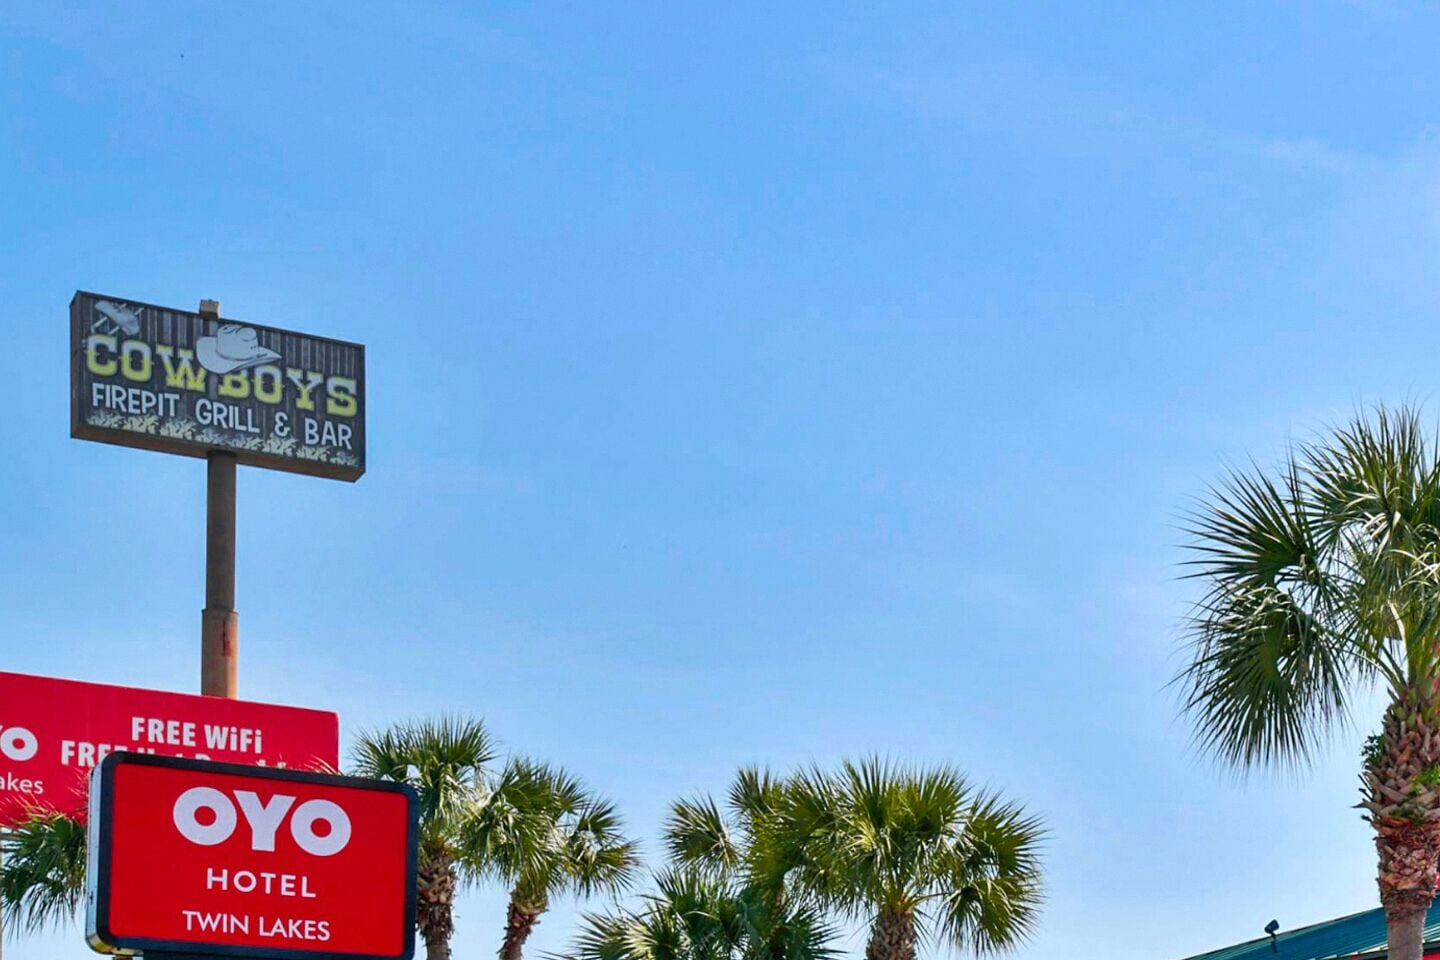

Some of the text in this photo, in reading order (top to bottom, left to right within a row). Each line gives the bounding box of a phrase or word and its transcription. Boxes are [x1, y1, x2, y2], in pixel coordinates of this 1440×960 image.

[83, 334, 357, 417] COWBOYS
[91, 382, 353, 450] FIREPIT GRILL & BAR
[131, 716, 263, 754] FREE WiFi
[173, 786, 352, 857] OYO
[206, 868, 317, 898] HOTEL
[182, 910, 331, 941] TWIN LAKES
